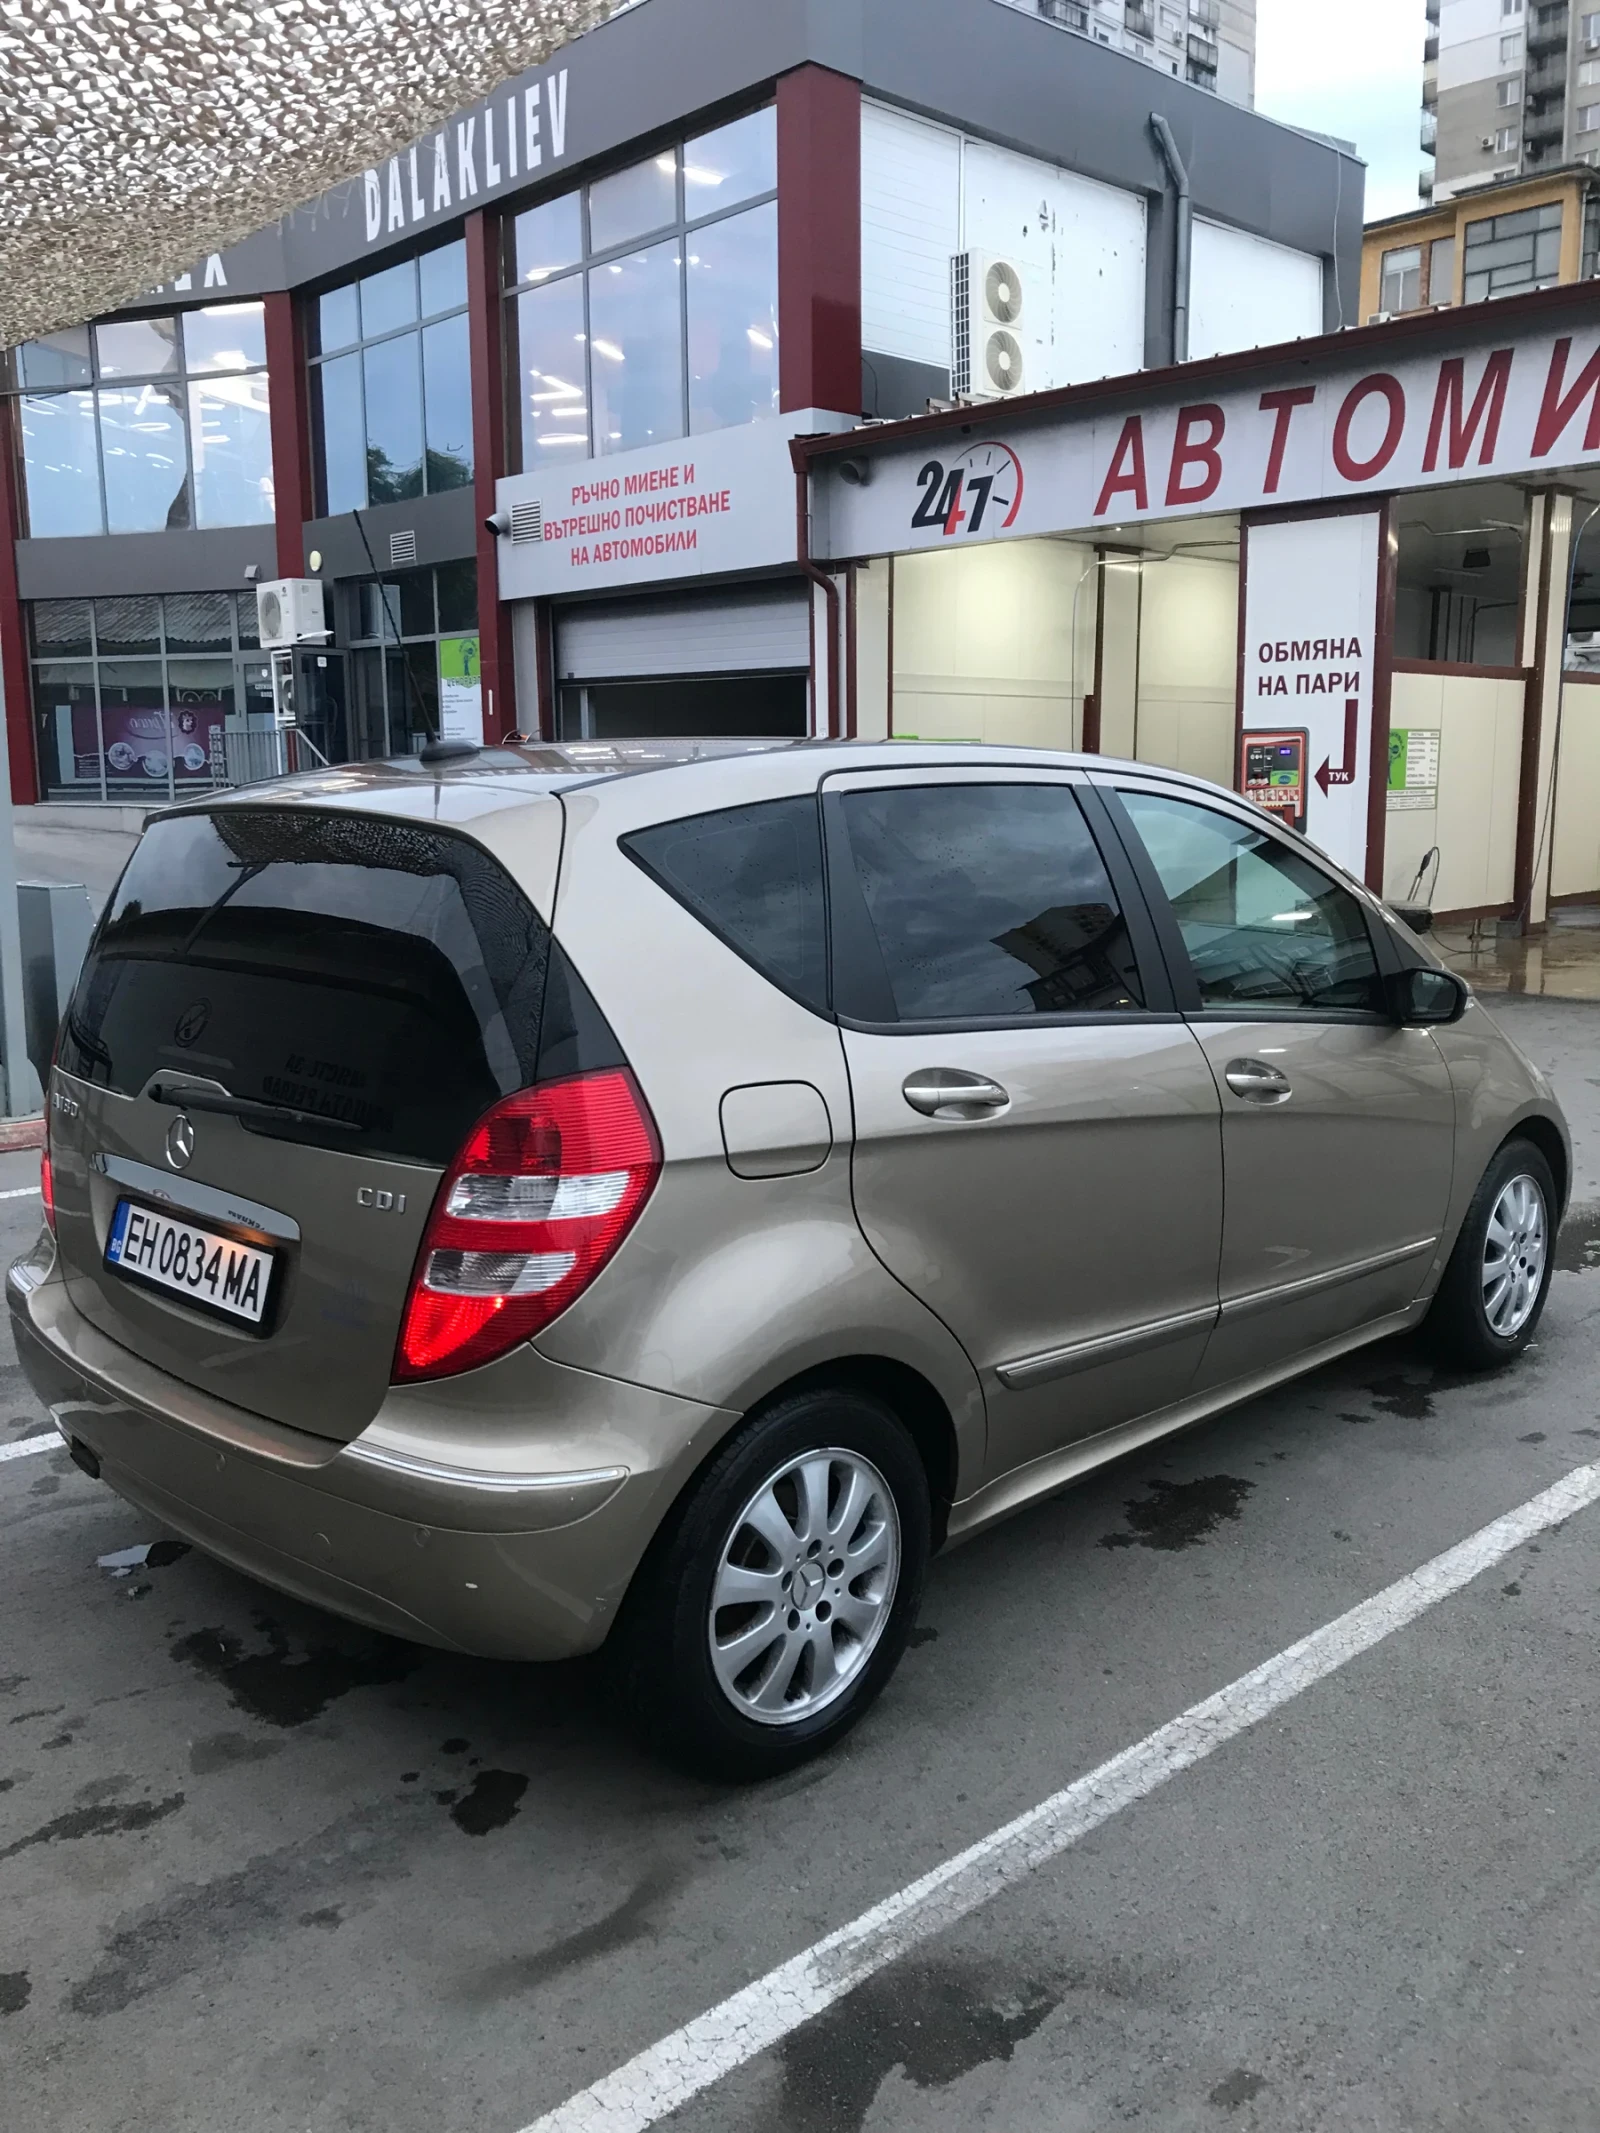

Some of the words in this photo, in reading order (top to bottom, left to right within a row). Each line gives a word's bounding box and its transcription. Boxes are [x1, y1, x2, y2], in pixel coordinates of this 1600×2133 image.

[364, 68, 568, 242] DALAKLIEV
[1093, 337, 1600, 516] АВТОМИ
[571, 478, 620, 506] РЪЧНО
[624, 466, 679, 496] МИЕНЕ
[683, 463, 695, 485] И
[544, 509, 621, 541] ВЪТРЕШНО
[625, 490, 731, 527] ПОЧИСТВАНЕ
[571, 546, 590, 566] НА
[593, 529, 697, 563] АВТОМОБИЛИ
[1258, 637, 1363, 663] ОБМЯНА
[1258, 675, 1289, 696] НА
[1296, 671, 1360, 695] ПАРИ
[1328, 771, 1349, 782] ТУК
[356, 1187, 406, 1213] CDI
[111, 1238, 122, 1254] BG
